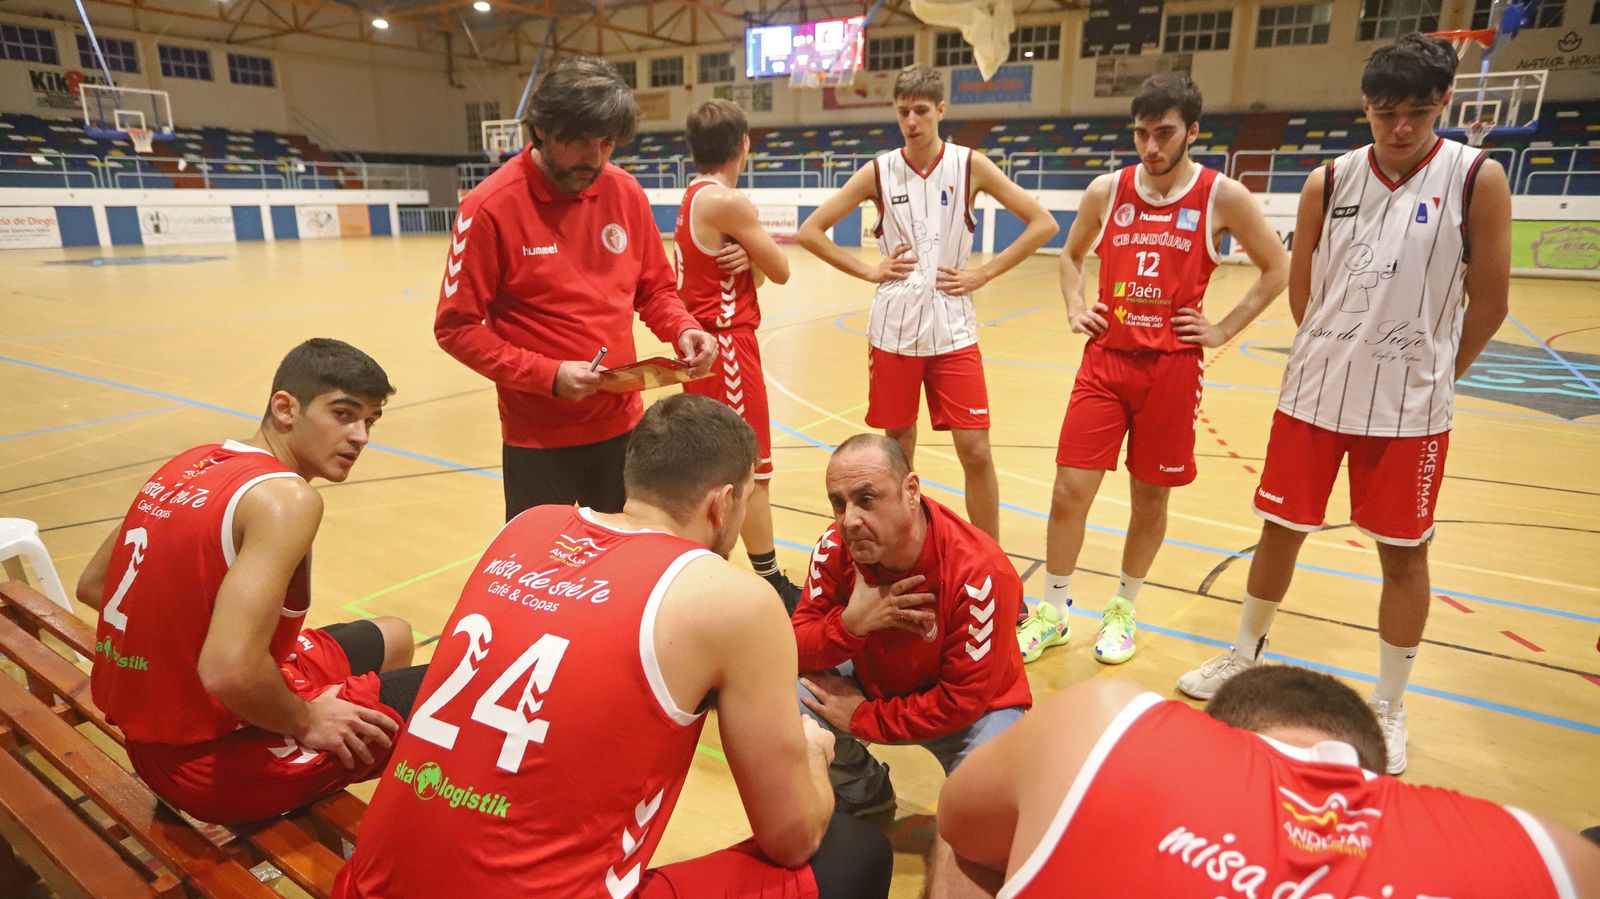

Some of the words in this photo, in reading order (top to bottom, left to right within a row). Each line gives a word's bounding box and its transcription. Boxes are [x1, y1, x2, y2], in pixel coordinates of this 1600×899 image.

[13, 216, 27, 226] de
[28, 216, 56, 228] Diego
[1139, 211, 1173, 223] hummel
[522, 243, 558, 257] hummel
[1112, 233, 1130, 247] CB
[1130, 231, 1192, 253] ANDÚJAR
[1135, 250, 1161, 277] 12
[1127, 281, 1162, 299] Jaén
[1127, 312, 1163, 323] Fundación
[1336, 322, 1363, 341] de
[1159, 464, 1185, 473] hummel
[1419, 440, 1439, 518] OKEYMAS
[1258, 487, 1285, 504] hummel
[103, 527, 148, 634] 2
[484, 554, 523, 580] misa
[518, 568, 559, 589] de
[487, 581, 510, 598] Café
[508, 588, 521, 602] &
[521, 593, 560, 612] Copas
[408, 613, 571, 774] 24
[394, 760, 415, 785] ska
[438, 777, 513, 819] logistik
